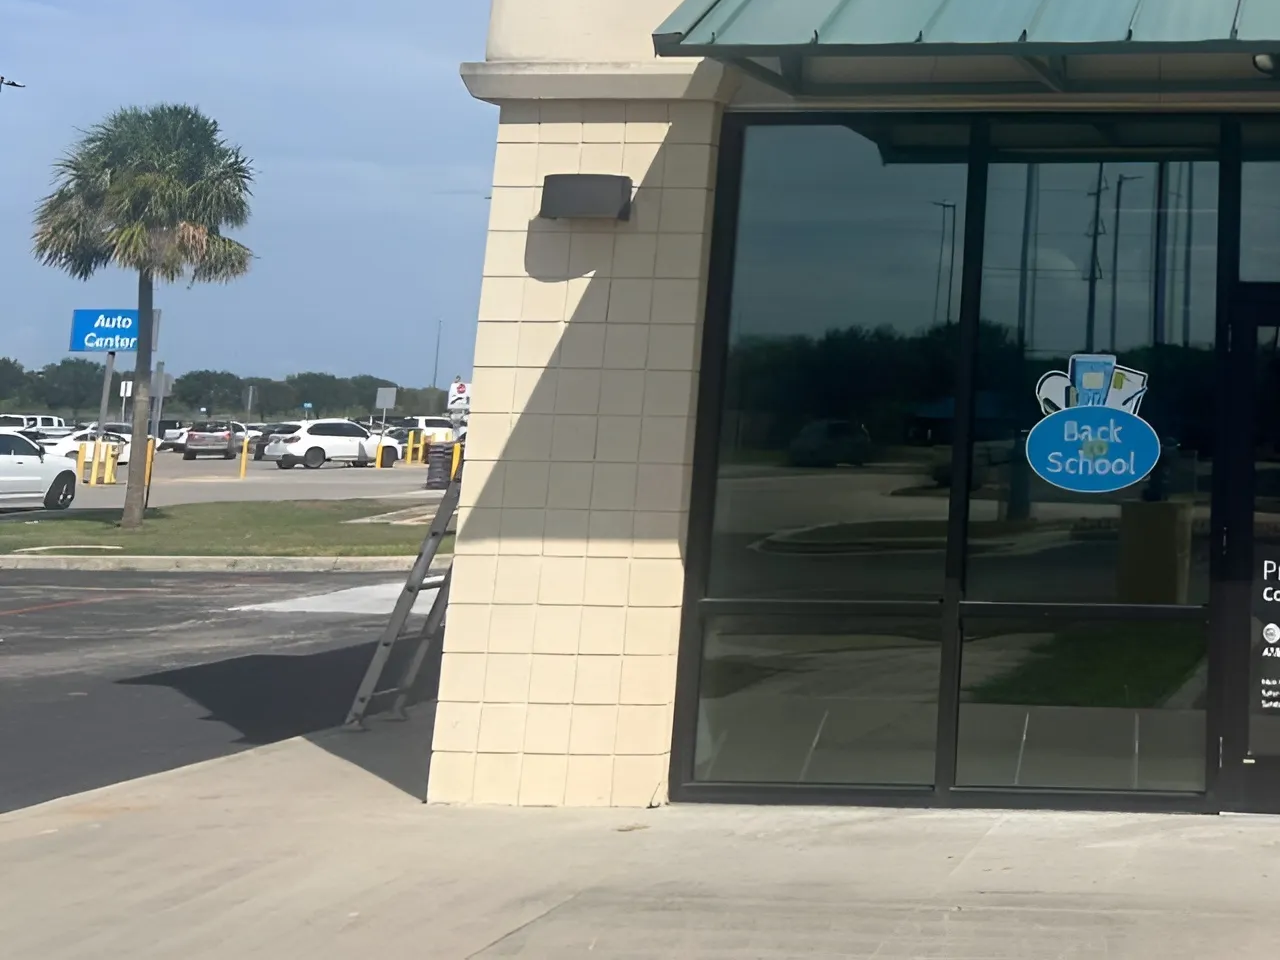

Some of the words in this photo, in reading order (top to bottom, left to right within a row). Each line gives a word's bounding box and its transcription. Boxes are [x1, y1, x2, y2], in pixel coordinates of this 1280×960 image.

[94, 314, 132, 329] Auto
[84, 332, 137, 350] Center
[1064, 419, 1122, 443] Back
[1046, 450, 1135, 475] School
